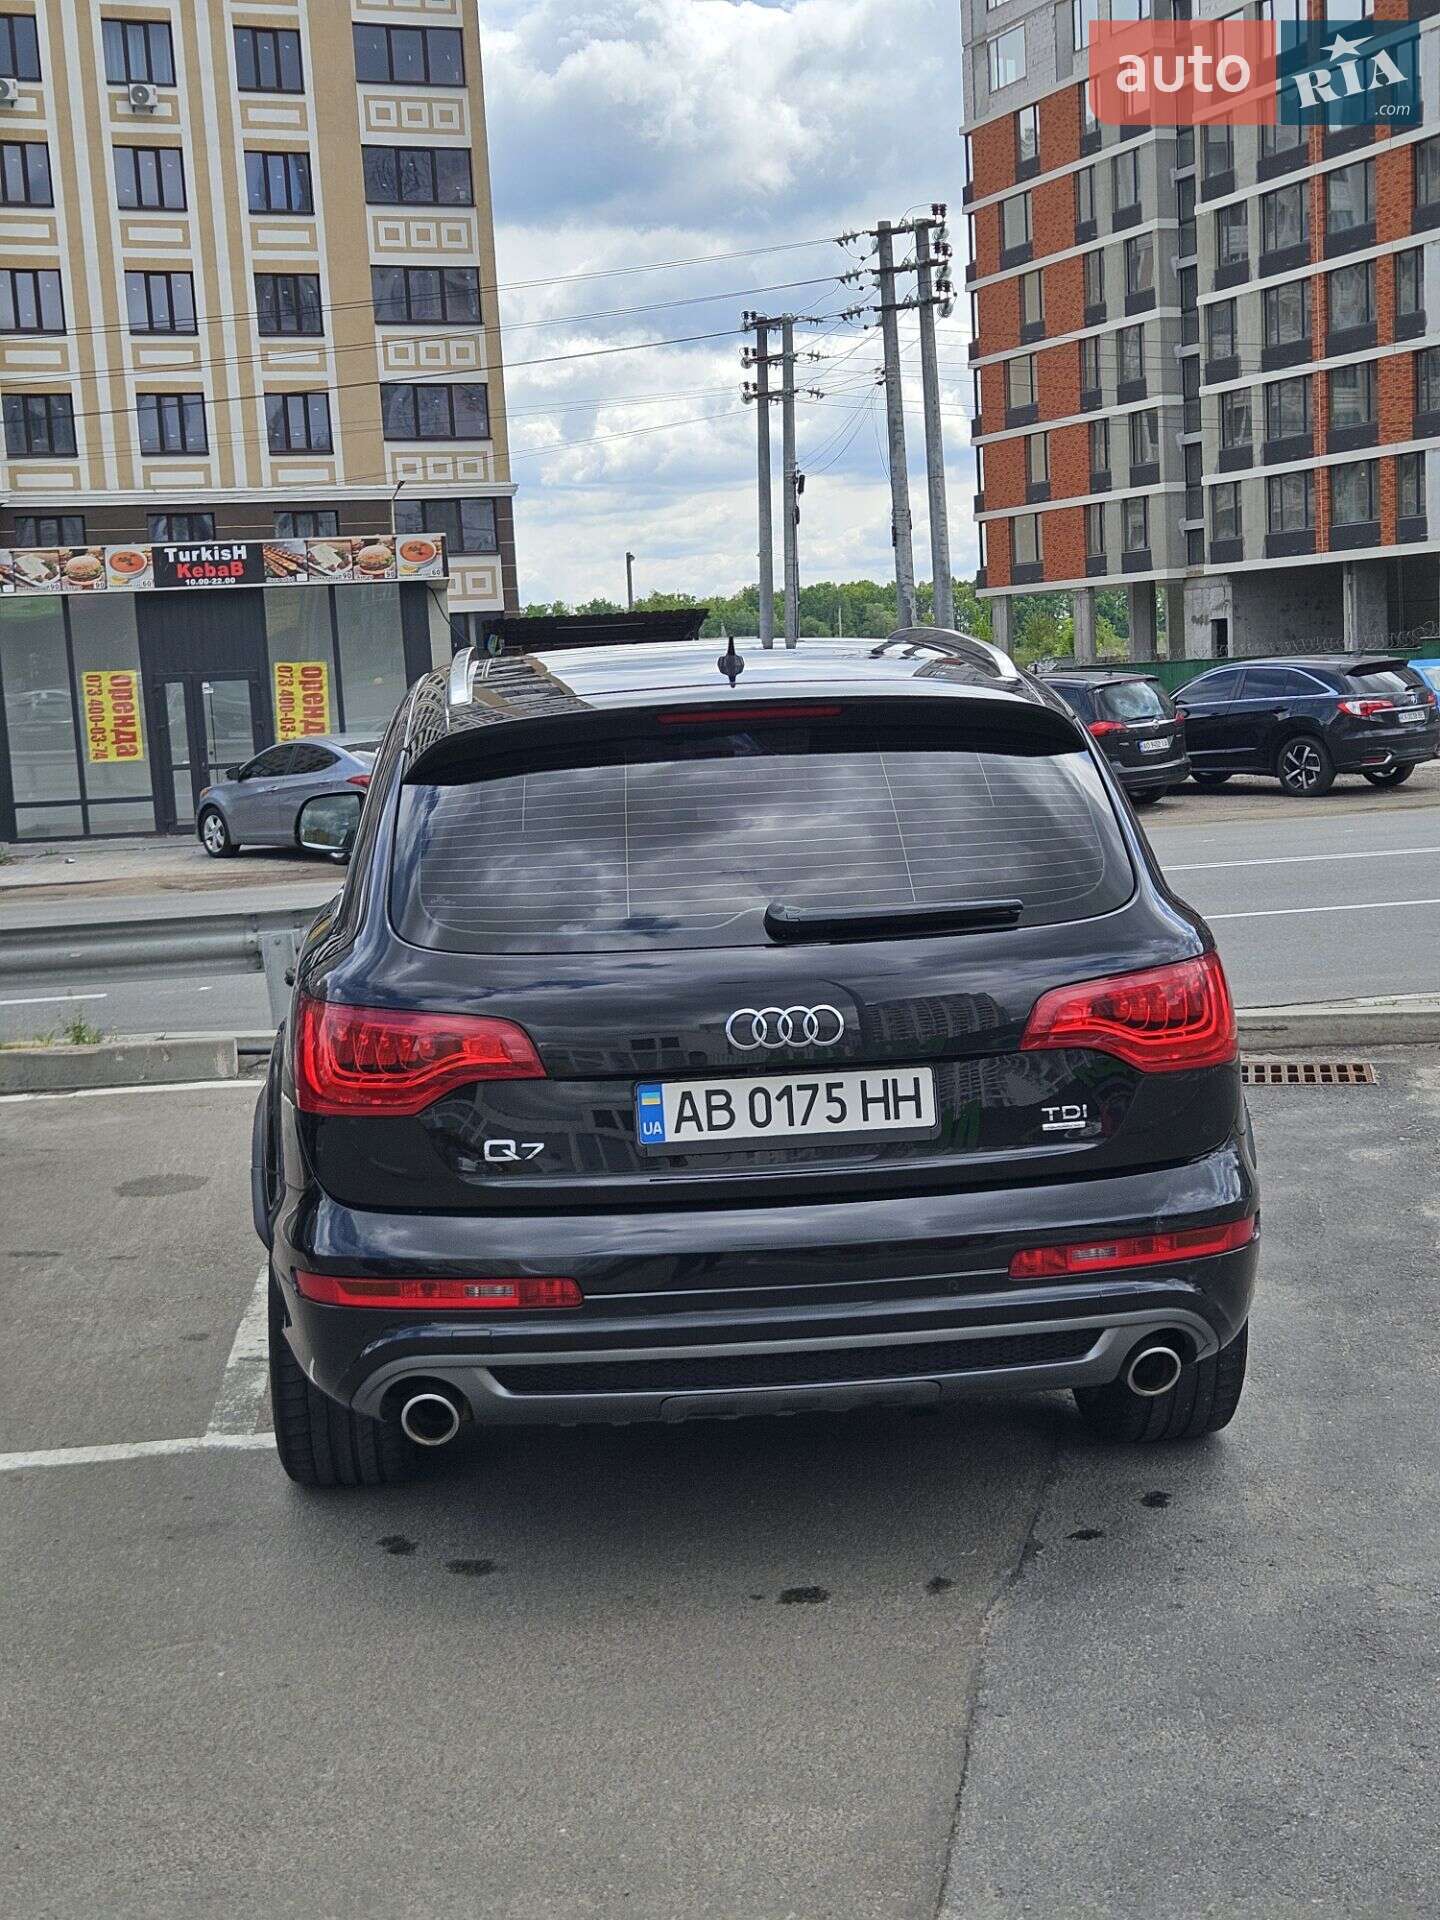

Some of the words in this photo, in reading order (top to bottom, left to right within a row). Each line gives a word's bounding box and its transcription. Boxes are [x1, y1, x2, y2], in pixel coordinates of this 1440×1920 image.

[164, 545, 247, 562] TurkisH
[176, 561, 244, 578] KebaB
[185, 577, 236, 586] 10.00-22.00
[86, 675, 103, 696] 073
[277, 666, 293, 686] 073
[299, 666, 325, 735] оренд
[108, 675, 139, 757] оренда
[88, 698, 108, 760] 400-03-74
[643, 1121, 663, 1135] UA
[674, 1089, 736, 1134] AB
[748, 1082, 847, 1128] 0175
[860, 1076, 922, 1122] HH
[484, 1139, 545, 1162] Q7
